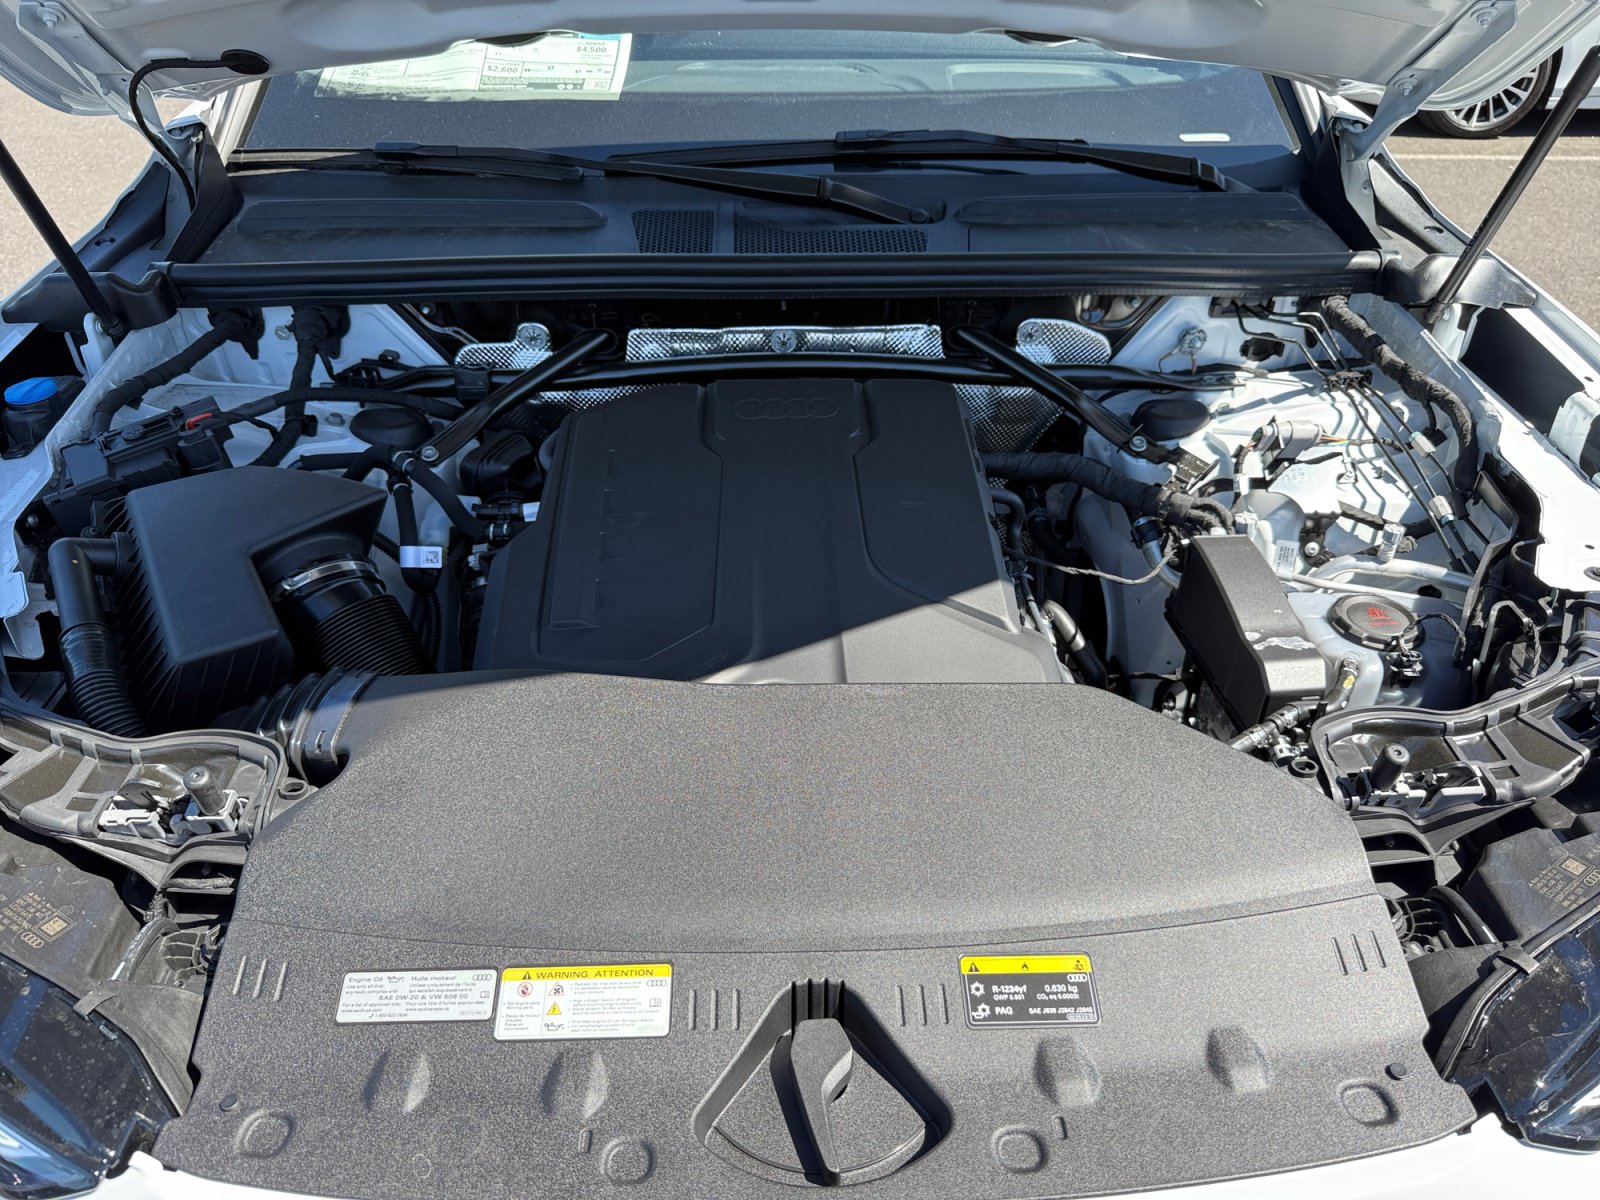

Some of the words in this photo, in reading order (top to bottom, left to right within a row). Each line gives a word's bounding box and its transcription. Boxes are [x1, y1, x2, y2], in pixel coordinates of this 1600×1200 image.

[487, 65, 518, 74] $2,600
[536, 970, 588, 979] WARNING
[594, 969, 654, 978] ATTENTION
[992, 984, 1027, 994] R-1234yf
[1068, 984, 1078, 994] kg
[994, 1006, 1013, 1015] PAG
